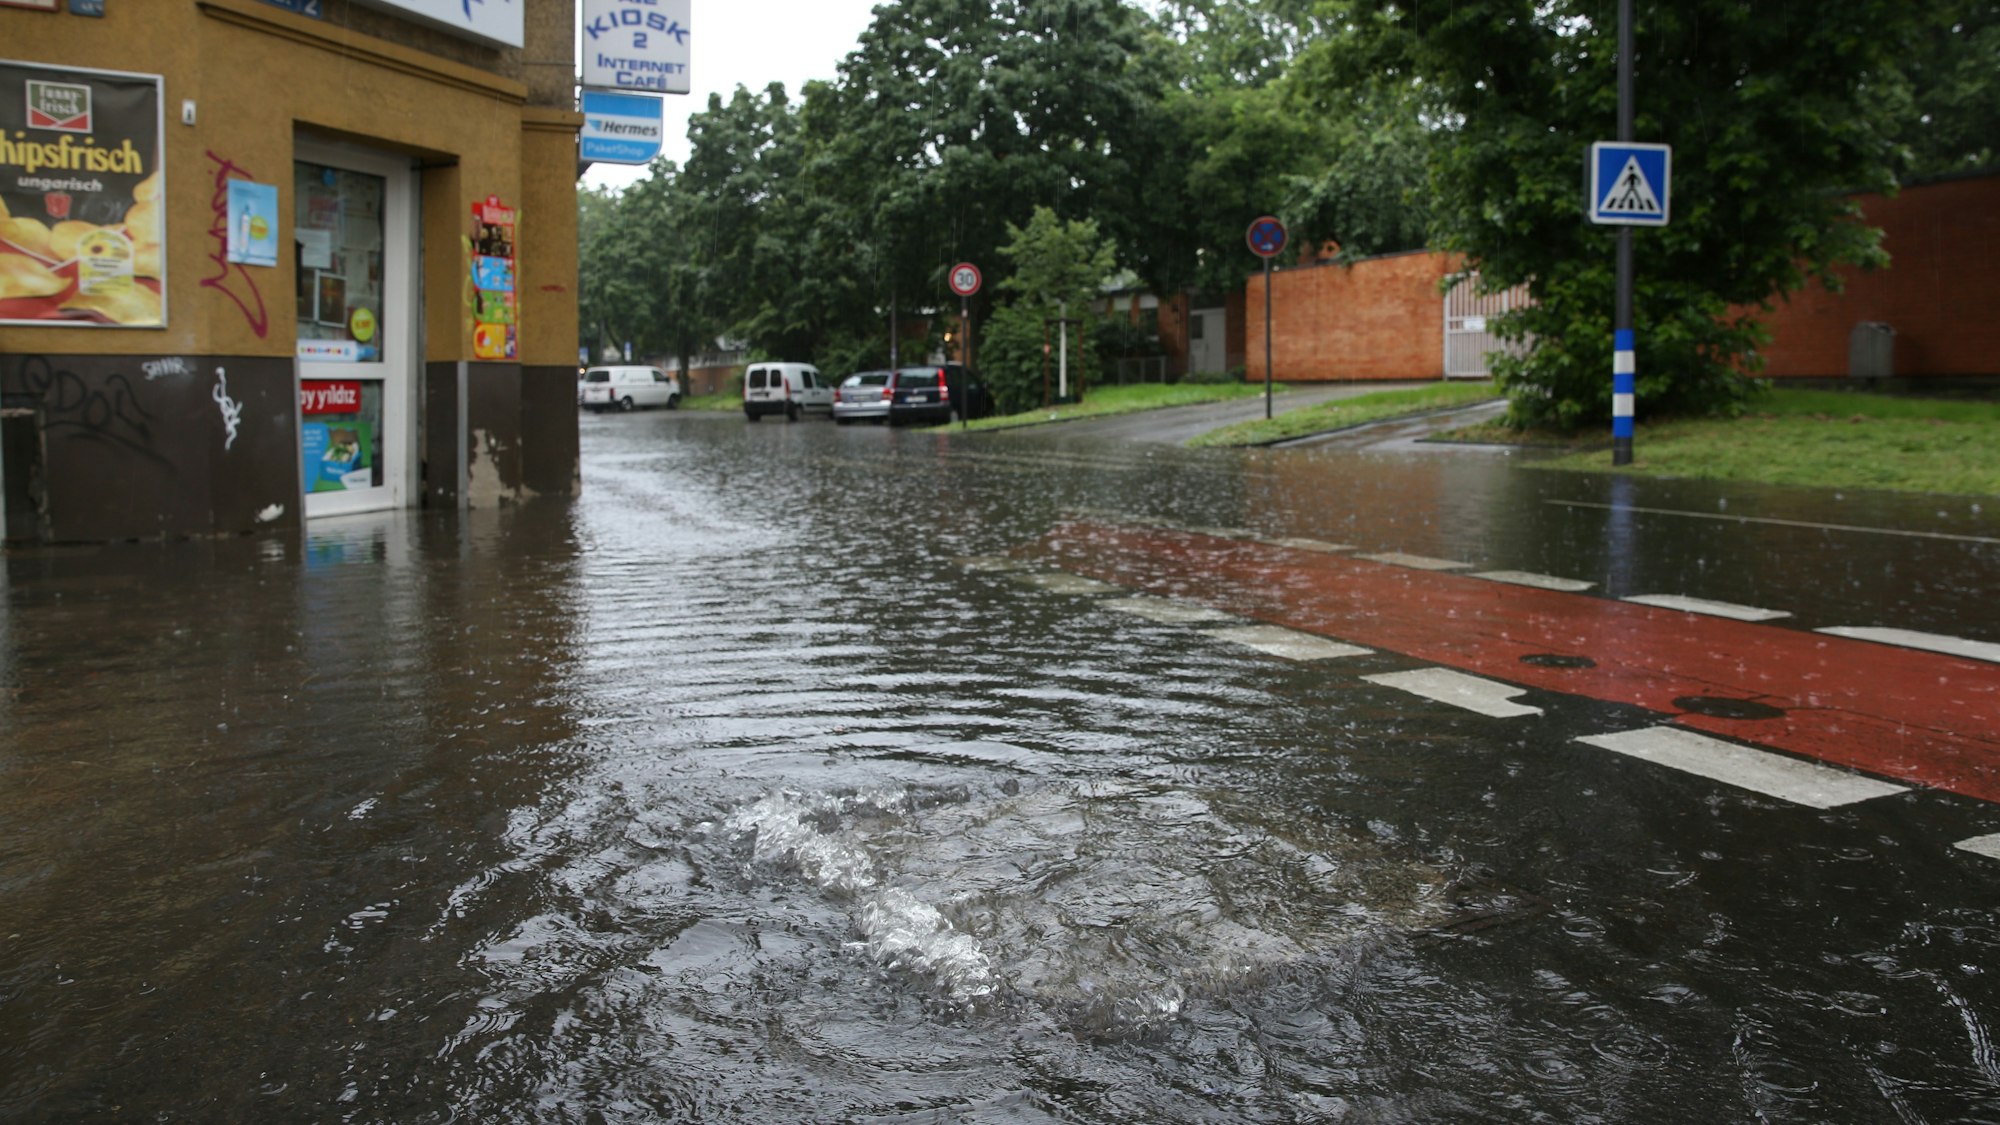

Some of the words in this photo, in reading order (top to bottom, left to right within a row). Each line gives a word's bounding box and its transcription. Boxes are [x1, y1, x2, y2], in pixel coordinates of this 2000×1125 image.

[586, 9, 690, 45] KIOSK
[633, 32, 648, 48] 2
[597, 53, 686, 75] INTERNET
[616, 71, 667, 89] CAFÉ
[39, 98, 80, 115] frisch
[604, 120, 658, 137] Hermes
[586, 141, 645, 157] PaketShop
[17, 176, 103, 193] ungarisch
[957, 272, 975, 287] 30
